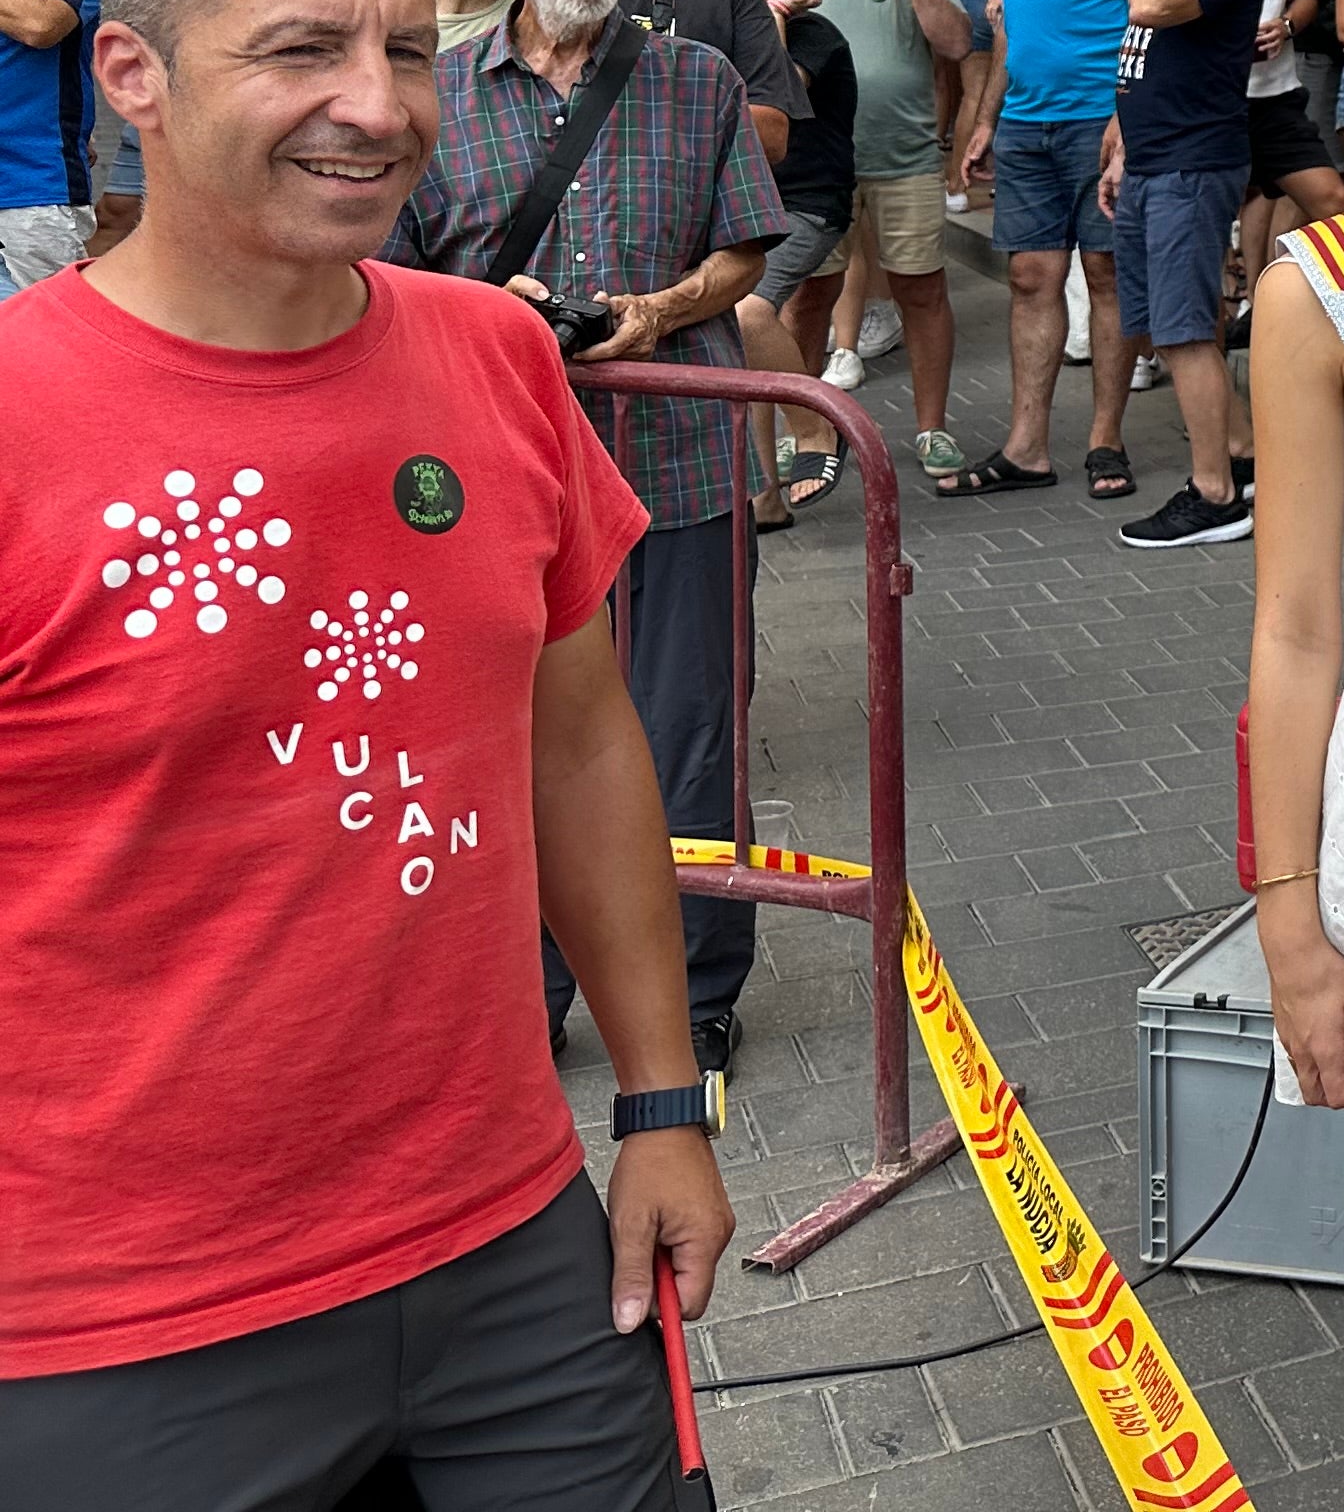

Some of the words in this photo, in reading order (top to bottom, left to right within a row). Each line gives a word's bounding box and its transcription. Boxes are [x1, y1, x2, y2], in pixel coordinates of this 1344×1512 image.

[1005, 1154, 1025, 1194] LA
[1017, 1179, 1059, 1255] NUCIA
[1012, 1128, 1041, 1185] POLICIA
[1039, 1175, 1064, 1226] LOCAL
[1097, 1384, 1134, 1403] EL
[1105, 1402, 1150, 1437] PASO
[1131, 1341, 1185, 1433] PROHIBIDO
